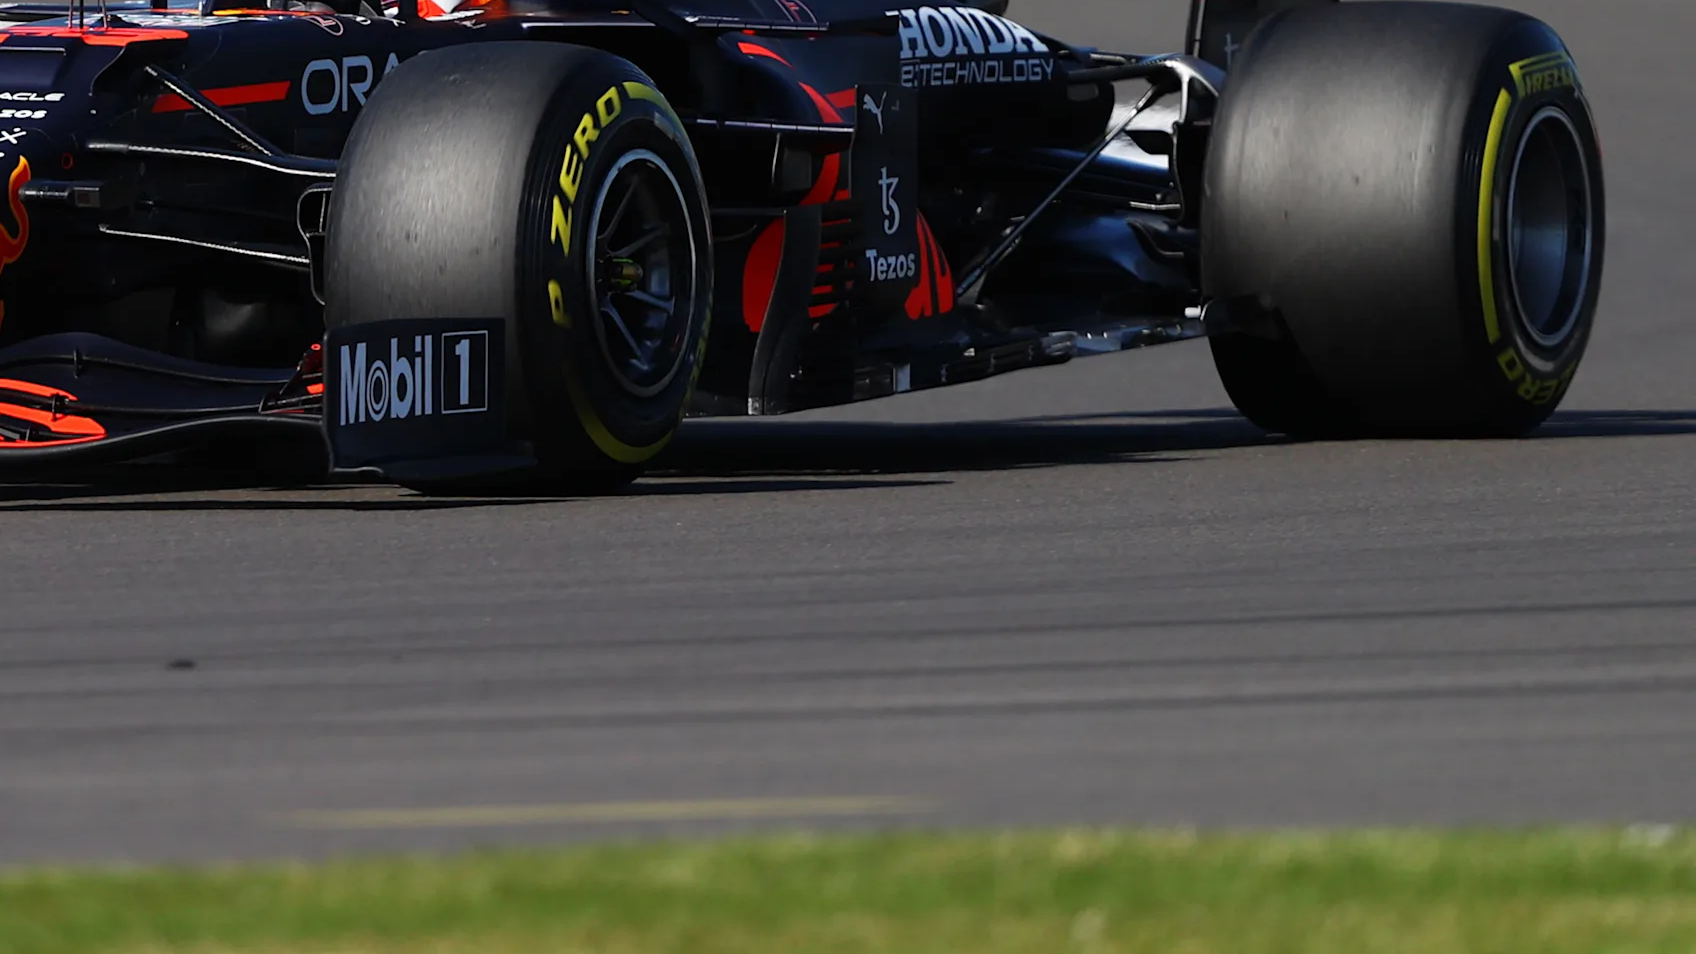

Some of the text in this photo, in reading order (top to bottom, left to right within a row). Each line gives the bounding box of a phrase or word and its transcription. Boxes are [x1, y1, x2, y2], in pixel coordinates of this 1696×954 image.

[884, 6, 1049, 58] HONDA
[548, 85, 623, 328] P ZERO
[865, 249, 916, 282] Tezos
[340, 335, 433, 426] Mobil
